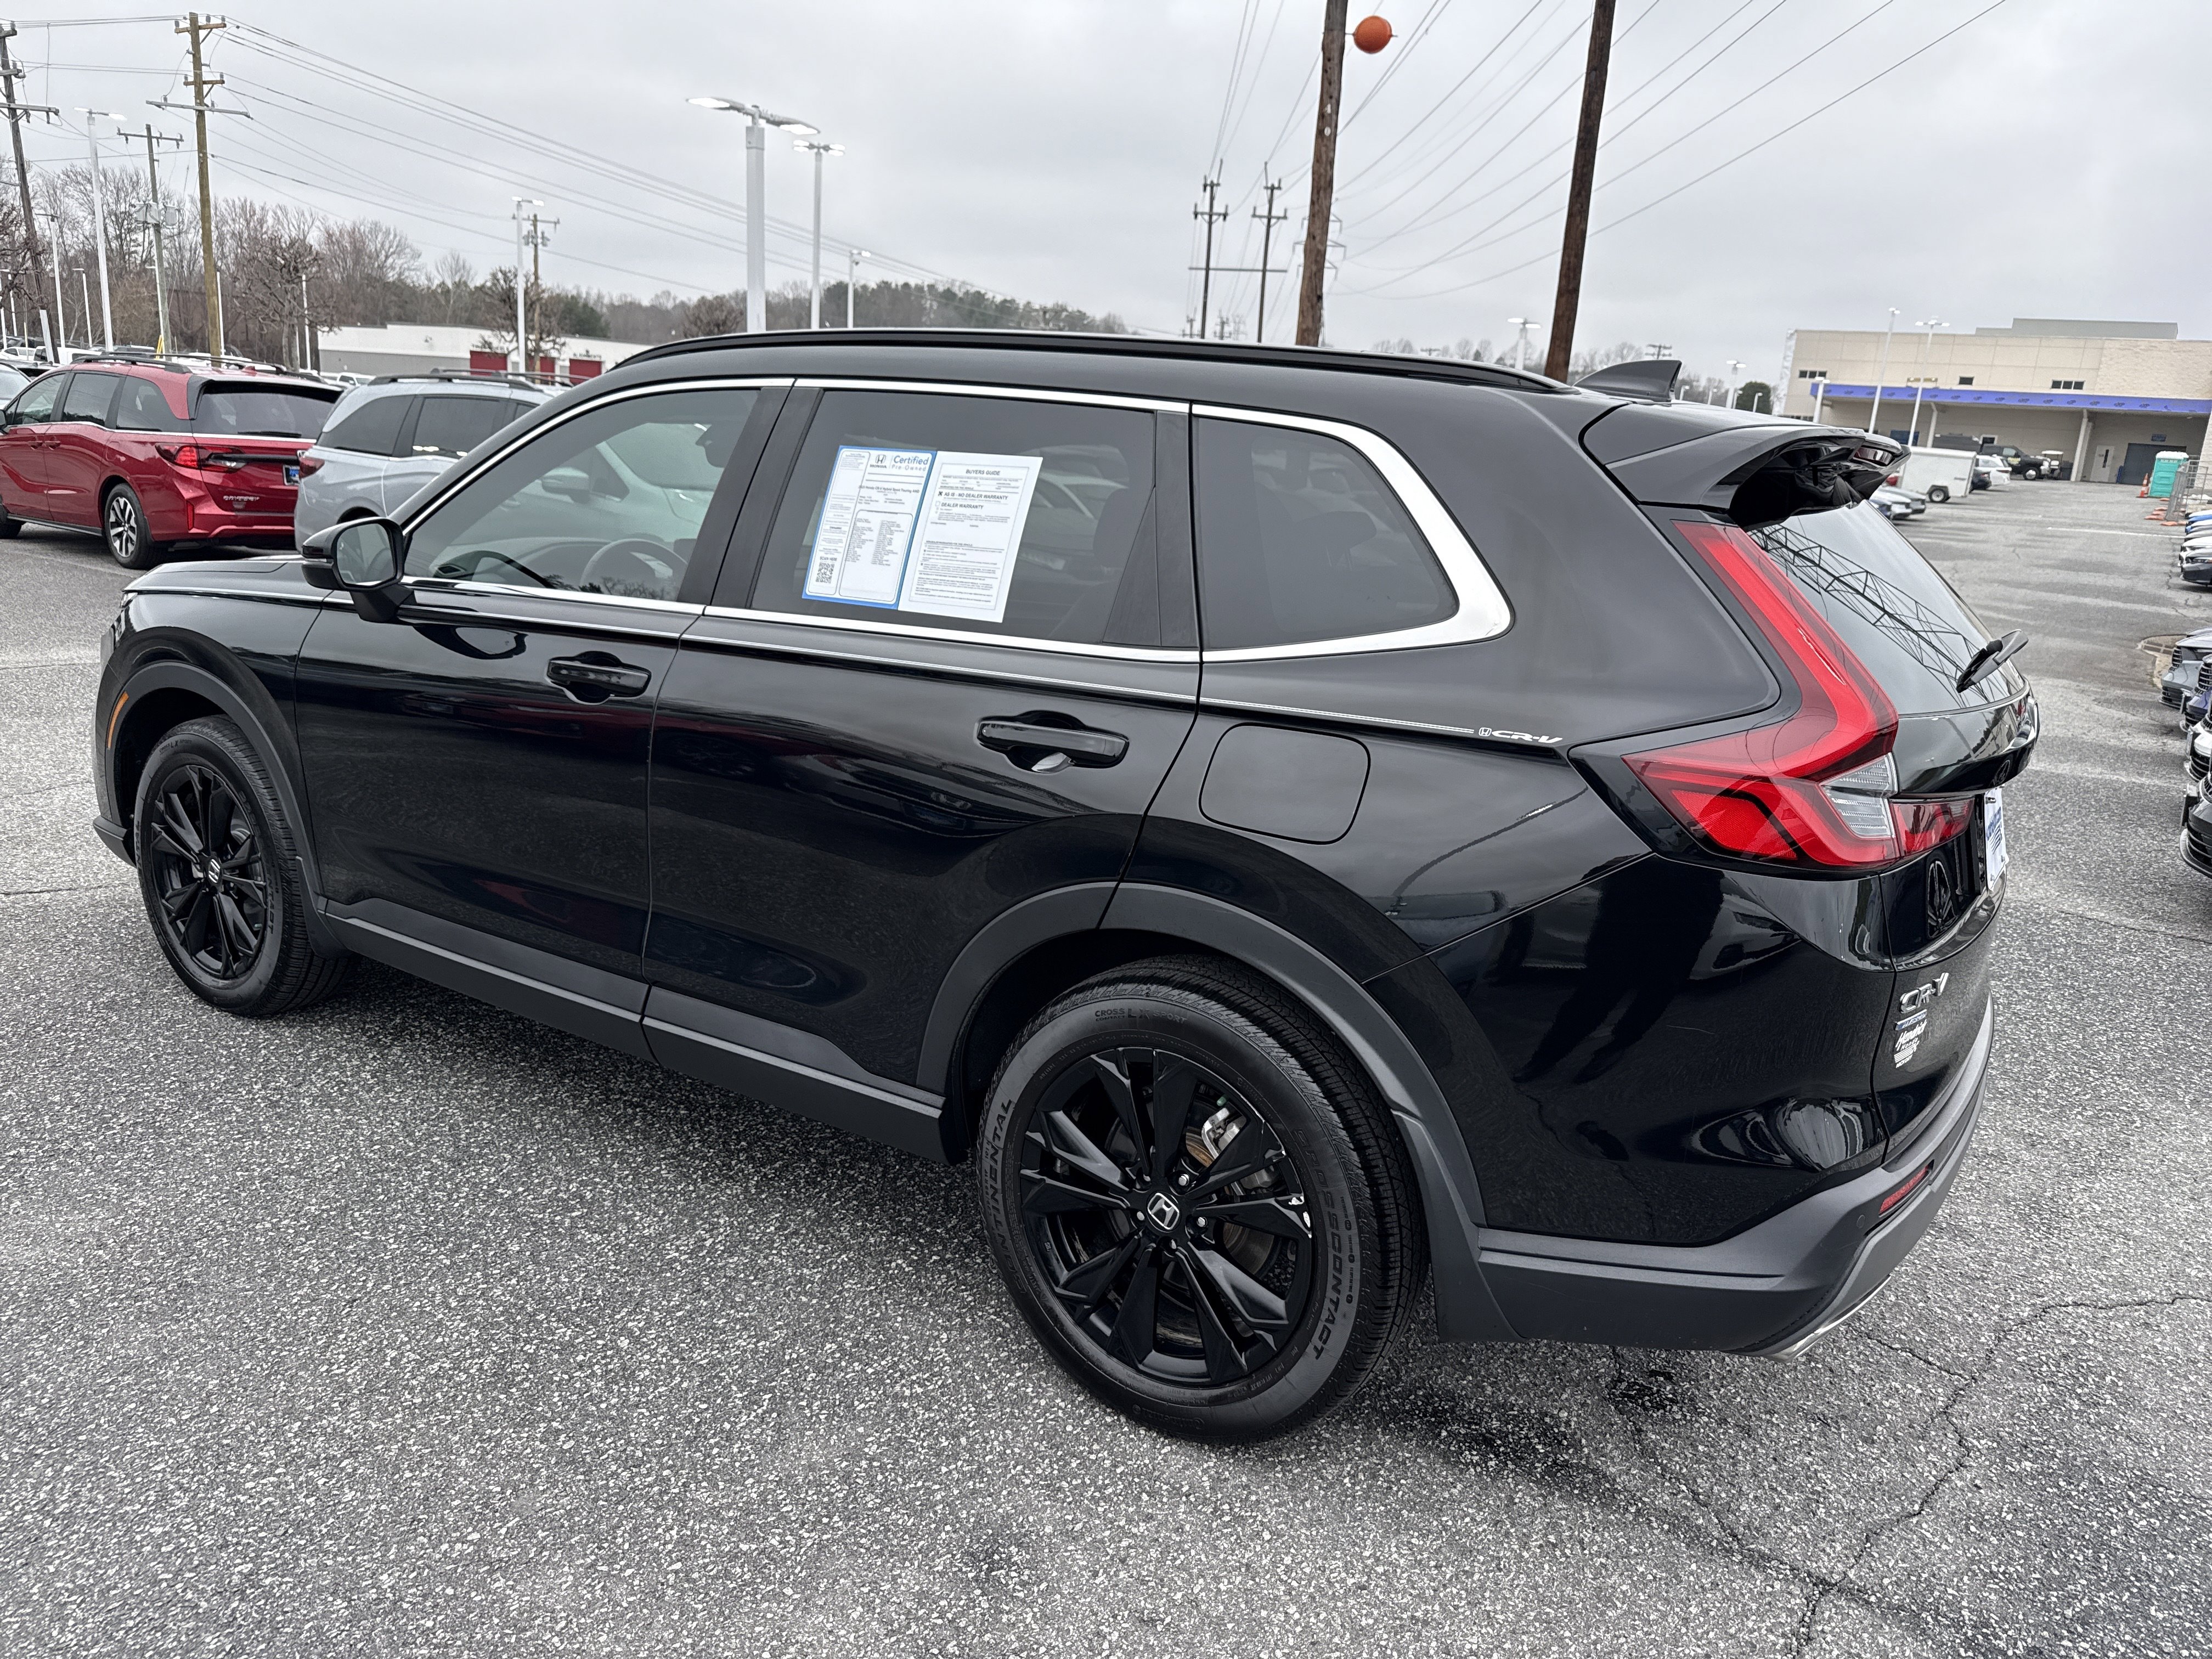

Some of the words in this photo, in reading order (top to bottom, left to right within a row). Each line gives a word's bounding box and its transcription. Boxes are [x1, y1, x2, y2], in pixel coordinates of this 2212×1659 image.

[894, 455, 929, 465] Certified
[1492, 730, 1563, 743] CR-V
[1899, 972, 1949, 1014] CR-V
[1095, 1008, 1125, 1017] CROSS
[1127, 1008, 1150, 1020] LX
[1153, 1010, 1188, 1024] SPORT
[989, 1099, 1027, 1294] CONTINENTAL
[1294, 1127, 1342, 1360] CROSSCONTACT
